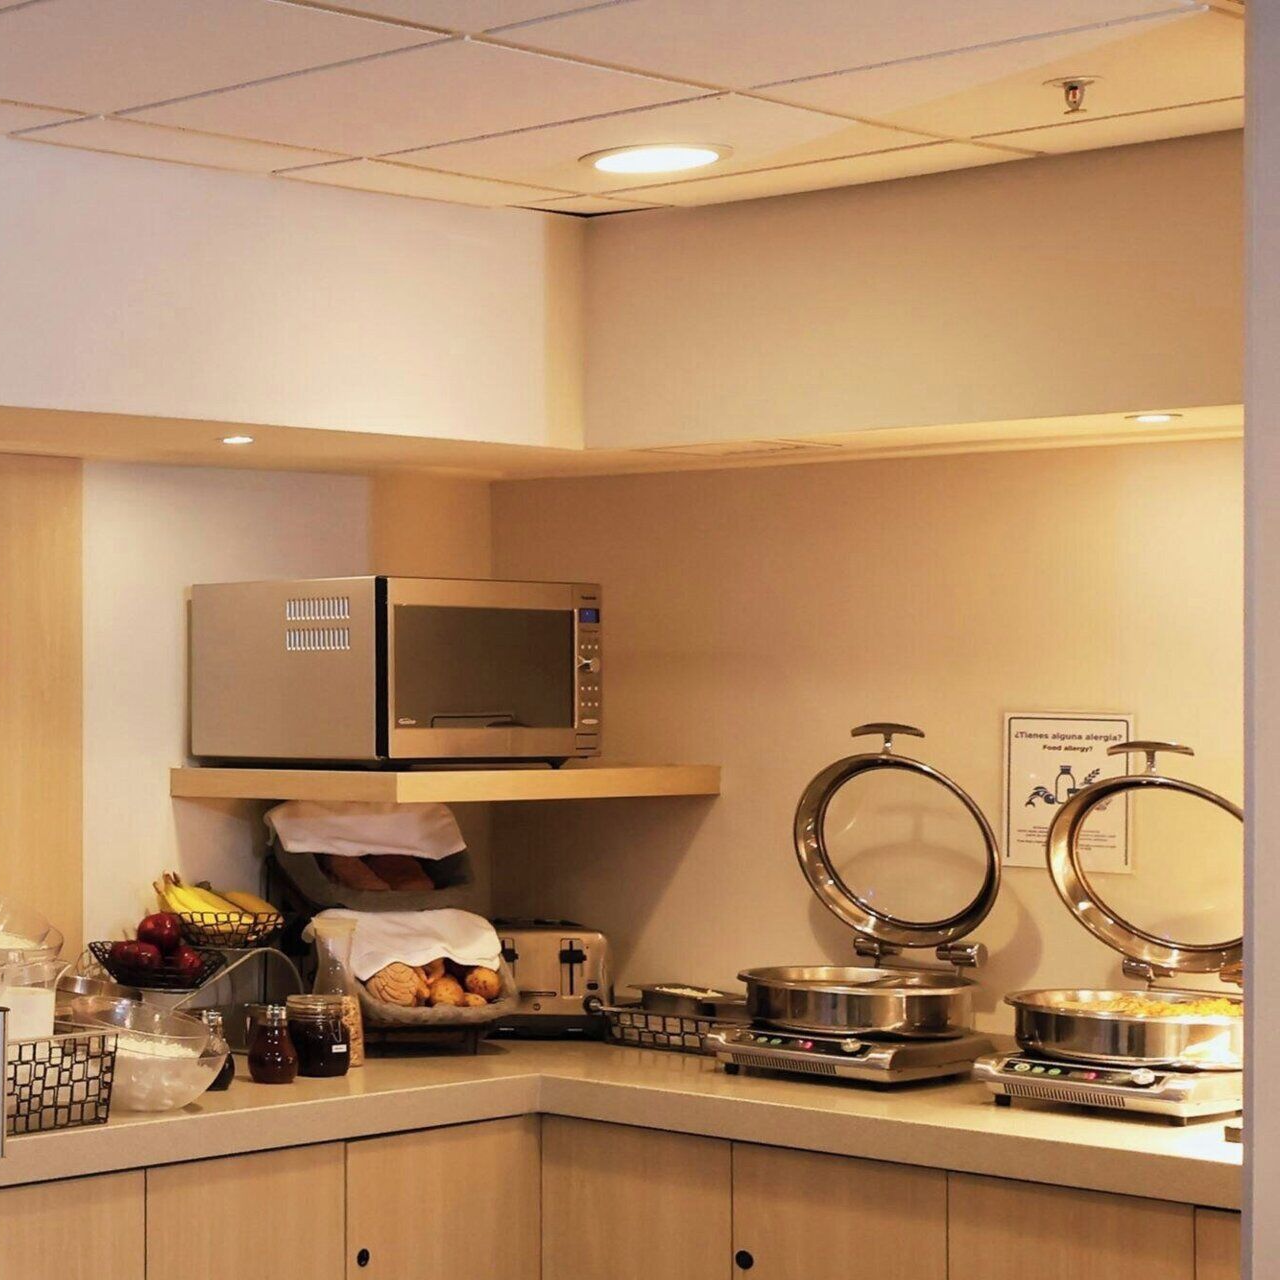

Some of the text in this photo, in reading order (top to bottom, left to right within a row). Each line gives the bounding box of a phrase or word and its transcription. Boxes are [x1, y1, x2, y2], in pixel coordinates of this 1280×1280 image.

[1014, 731, 1122, 742] ¿Tienes alguna alergia?
